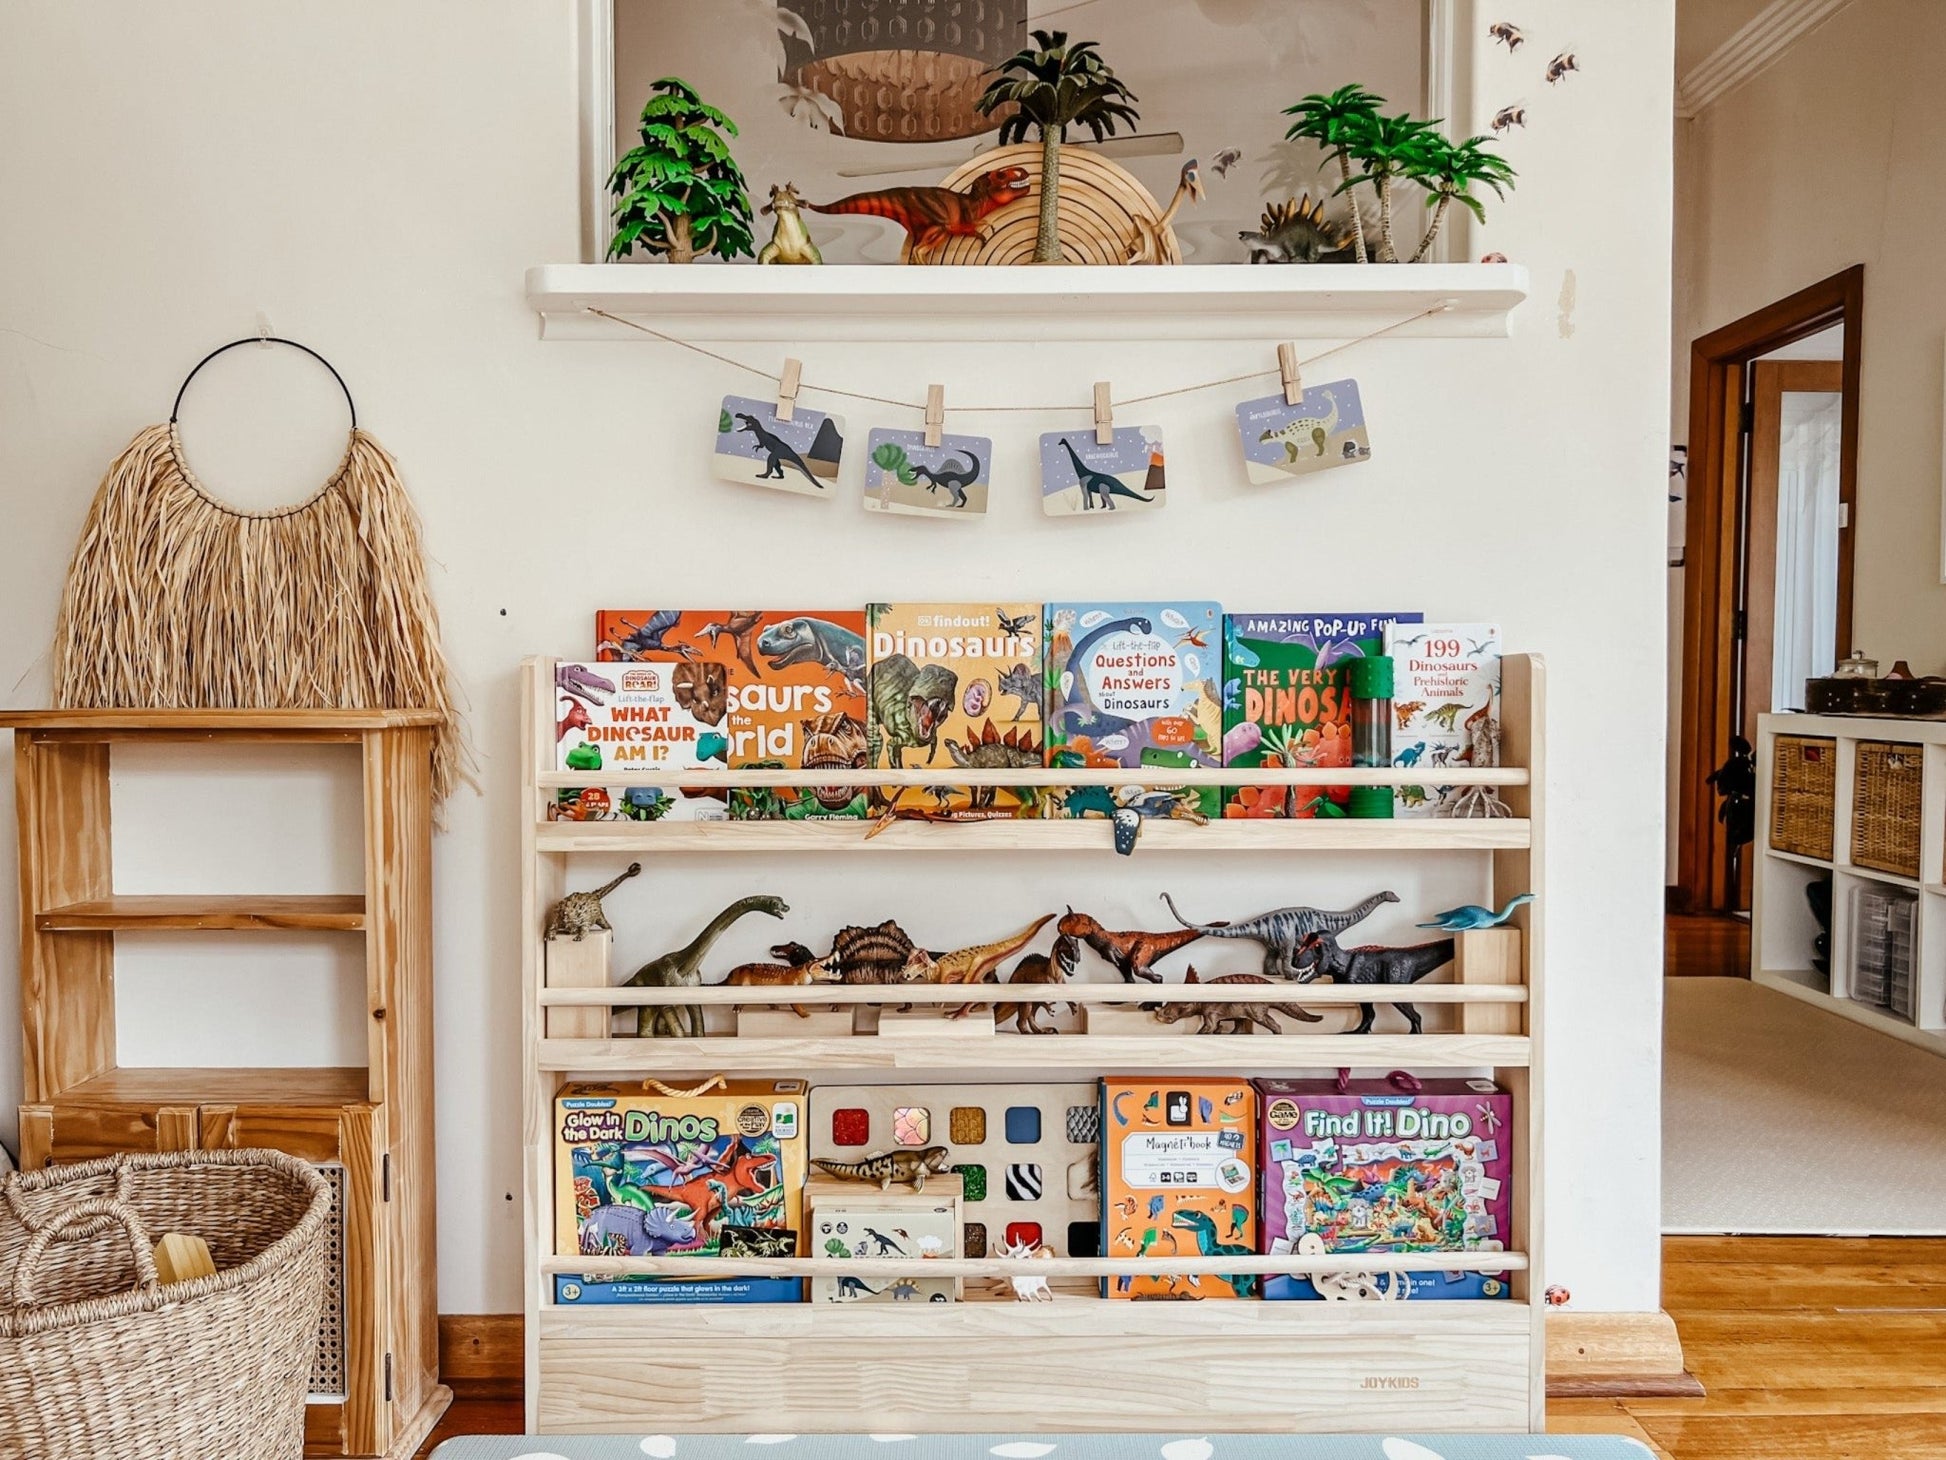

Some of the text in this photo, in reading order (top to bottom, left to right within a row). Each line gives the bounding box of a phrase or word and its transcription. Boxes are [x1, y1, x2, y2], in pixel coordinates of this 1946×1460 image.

[933, 615, 990, 628] findout!
[1247, 618, 1310, 633] AMAZING
[1314, 619, 1367, 637] POP-UP
[873, 631, 1035, 658] Dinosaurs
[1424, 639, 1460, 658] 199
[1095, 653, 1176, 668] Questions
[1409, 660, 1478, 672] Dinosaurs
[1128, 668, 1144, 677] and
[1243, 668, 1337, 686] THE VERY
[1102, 676, 1170, 690] Answers
[1413, 676, 1469, 686] Prehistoric
[726, 683, 833, 713] saurs
[1421, 687, 1464, 697] Animals
[1104, 698, 1170, 710] Dinosaurs
[611, 706, 671, 722] WHAT
[731, 714, 752, 726] the
[587, 726, 696, 742] DINOSAUR
[613, 745, 669, 761] AM I?
[587, 792, 600, 801] 28
[958, 811, 986, 820] Pictures,
[987, 811, 1012, 819] Quizzes
[567, 1112, 620, 1127] Glow in
[1305, 1108, 1472, 1140] Find It! Dino
[563, 1126, 623, 1141] the Dark
[625, 1111, 717, 1144] Dinos
[565, 1286, 578, 1296] 3+
[659, 1285, 680, 1294] puzzle
[695, 1285, 713, 1294] glows
[1485, 1281, 1499, 1292] 3+
[1360, 1376, 1420, 1389] JOYKIDS
